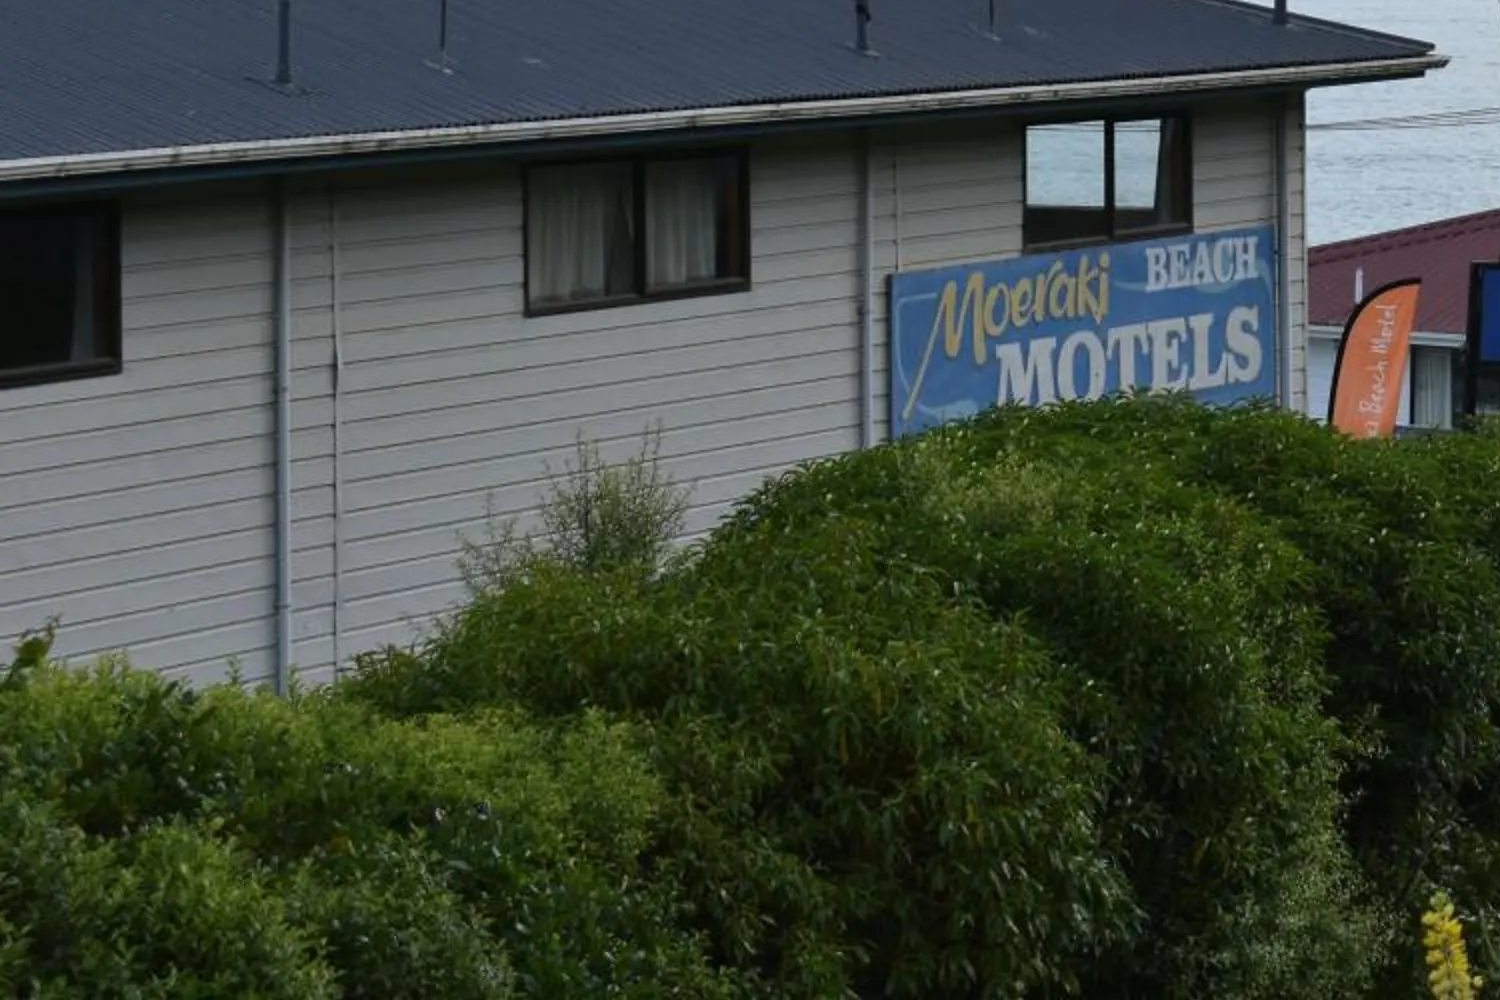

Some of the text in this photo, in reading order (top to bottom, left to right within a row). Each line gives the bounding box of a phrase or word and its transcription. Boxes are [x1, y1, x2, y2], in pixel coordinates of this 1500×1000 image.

[903, 236, 1259, 418] Moeraki BEACH
[995, 305, 1264, 408] MOTELS
[1368, 304, 1398, 354] Motel
[1358, 359, 1389, 414] Beach
